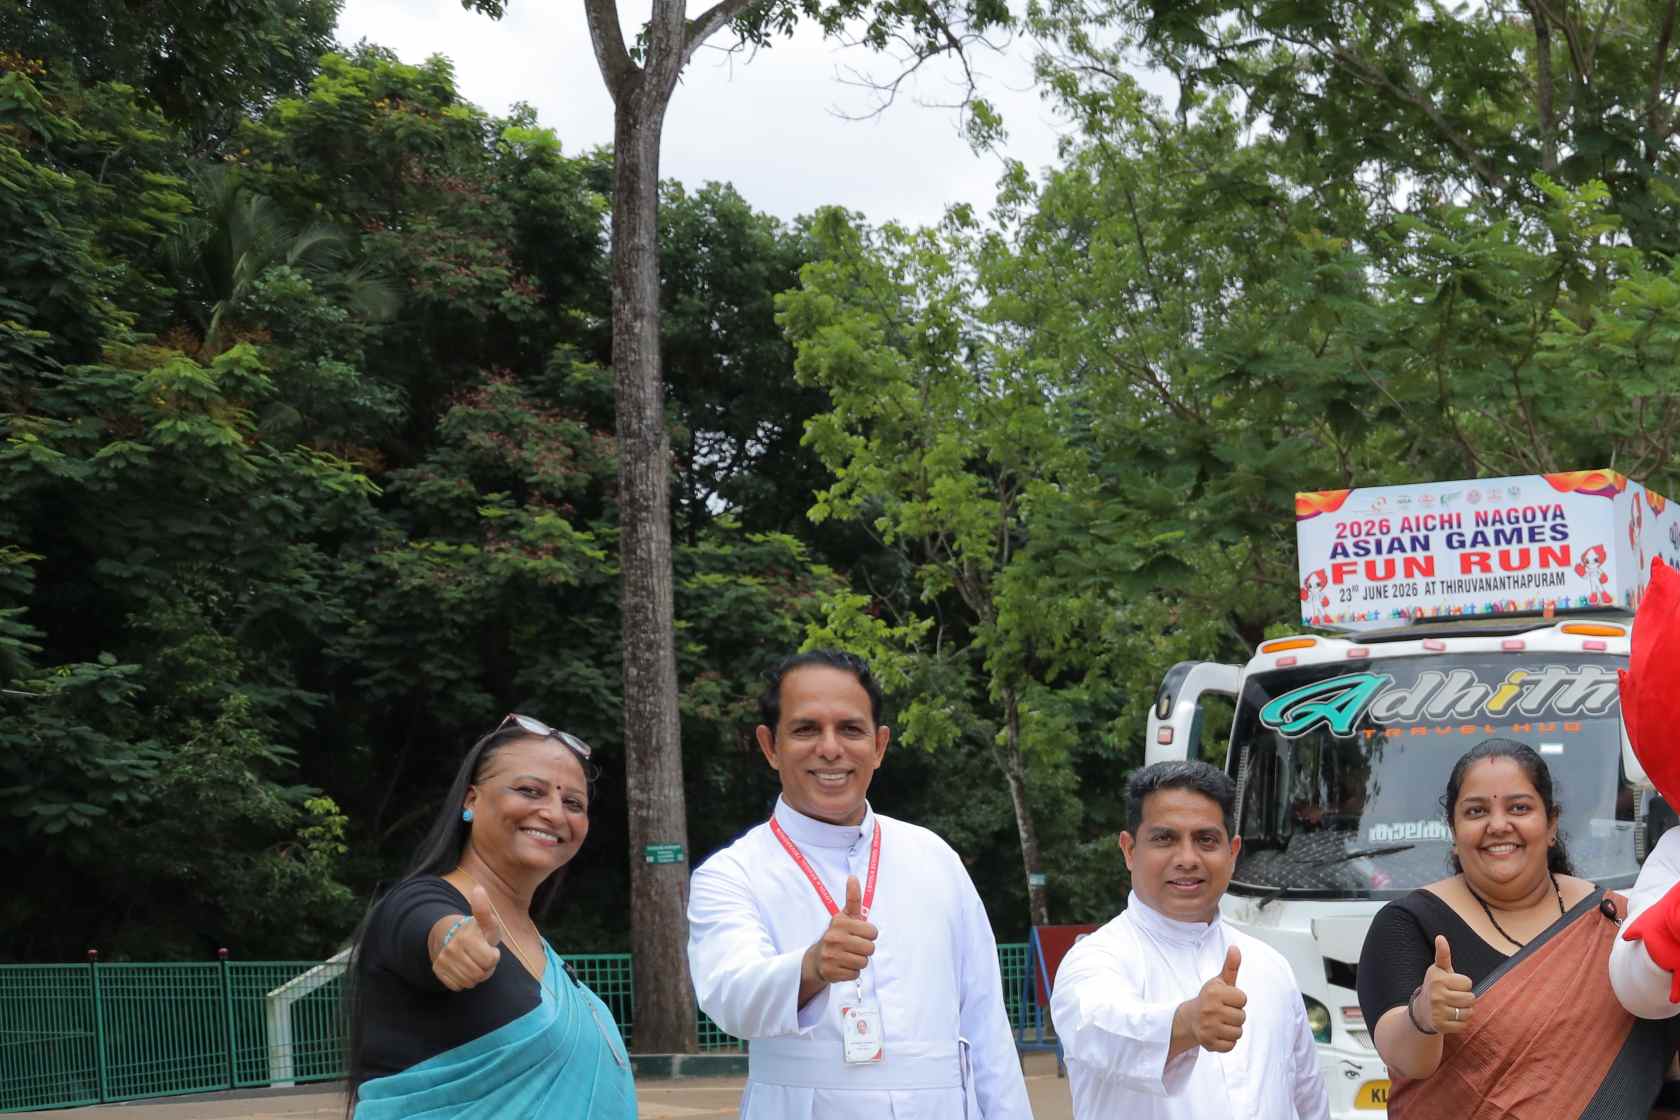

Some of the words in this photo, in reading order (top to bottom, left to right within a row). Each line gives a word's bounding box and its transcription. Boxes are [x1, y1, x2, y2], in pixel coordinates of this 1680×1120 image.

[1335, 518, 1391, 540] 2026
[1399, 512, 1463, 534] AICHI
[1474, 503, 1566, 528] NAGOYA
[1329, 533, 1431, 560] ASIAN
[1445, 523, 1569, 550] GAMES
[1331, 555, 1436, 585] FUN
[1459, 544, 1572, 575] RUN
[1362, 584, 1389, 601] JUNE
[1392, 582, 1418, 599] 2026
[1424, 581, 1436, 596] AT
[1440, 571, 1566, 595] THIRUVANANTHAPURAM
